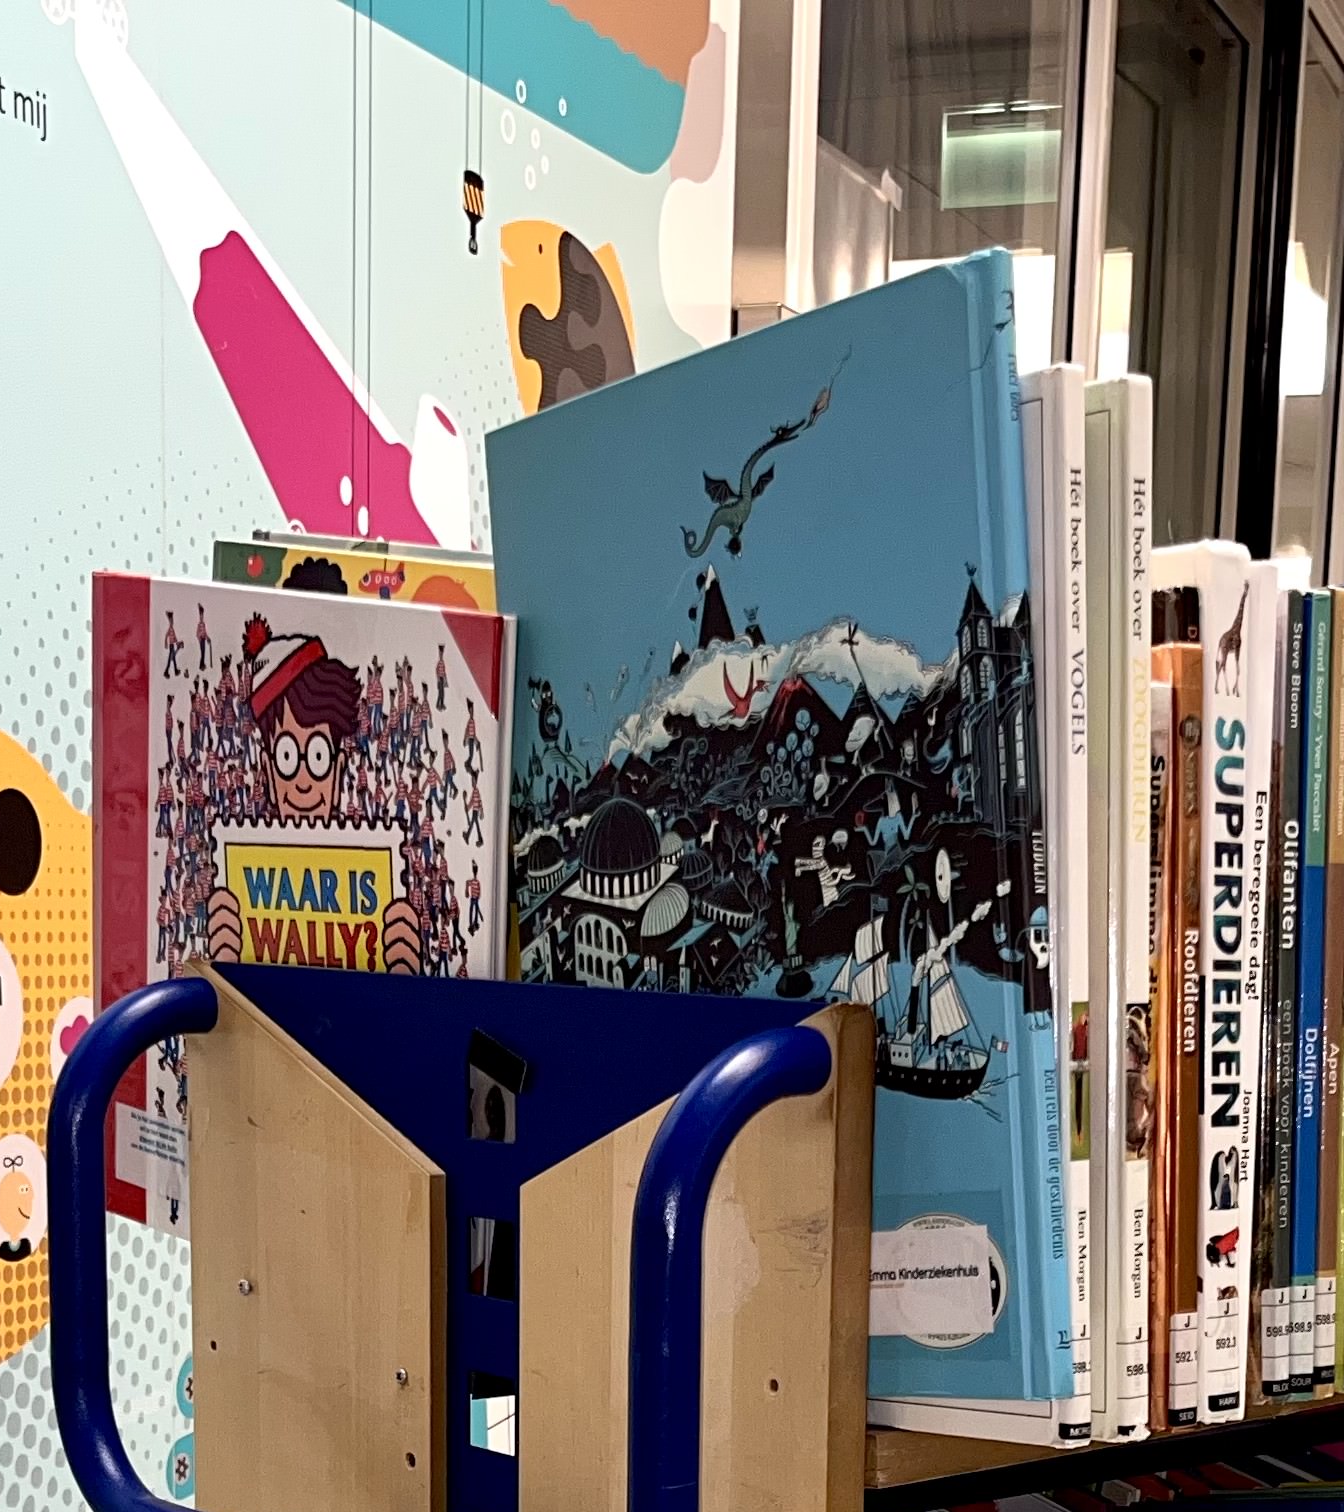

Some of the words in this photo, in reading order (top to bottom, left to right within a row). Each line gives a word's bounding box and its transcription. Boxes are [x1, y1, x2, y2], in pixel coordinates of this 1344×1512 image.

[13, 90, 47, 141] mij
[1070, 467, 1082, 509] Hét
[1133, 477, 1146, 519] Hét
[1070, 517, 1082, 572] boek
[1133, 526, 1146, 583] boek
[1070, 581, 1081, 635] over
[1132, 589, 1144, 642] over
[1291, 622, 1304, 671] Steve
[1317, 621, 1327, 664] Gérard
[1070, 647, 1086, 756] VOGELS
[1290, 673, 1302, 730] Bloom
[1255, 790, 1268, 833] Een
[243, 867, 338, 914] WAAR
[350, 870, 378, 916] IS
[1248, 839, 1267, 945] beregoeie
[1280, 819, 1299, 950] Olifanten
[247, 917, 379, 972] WALLY?
[1211, 716, 1246, 1128] SUPERDIEREN
[1184, 929, 1199, 1053] Roofdieren
[1246, 948, 1260, 1000] dag!
[1283, 999, 1293, 1030] een
[1281, 1036, 1293, 1081] boek
[1302, 1027, 1318, 1119] Dolfijnen
[1328, 1042, 1339, 1095] Apen
[1241, 1089, 1252, 1135] Joanna
[1281, 1091, 1290, 1137] voor
[1239, 1138, 1249, 1182] Hart
[1278, 1143, 1290, 1230] kinderen
[1046, 1176, 1063, 1260] geschiedenis
[1078, 1209, 1087, 1239] Ben
[1134, 1208, 1143, 1237] Ben
[898, 1263, 979, 1281] Kinderziekenhuis
[1078, 1243, 1088, 1303] Morgan
[1133, 1241, 1144, 1299] Morgan
